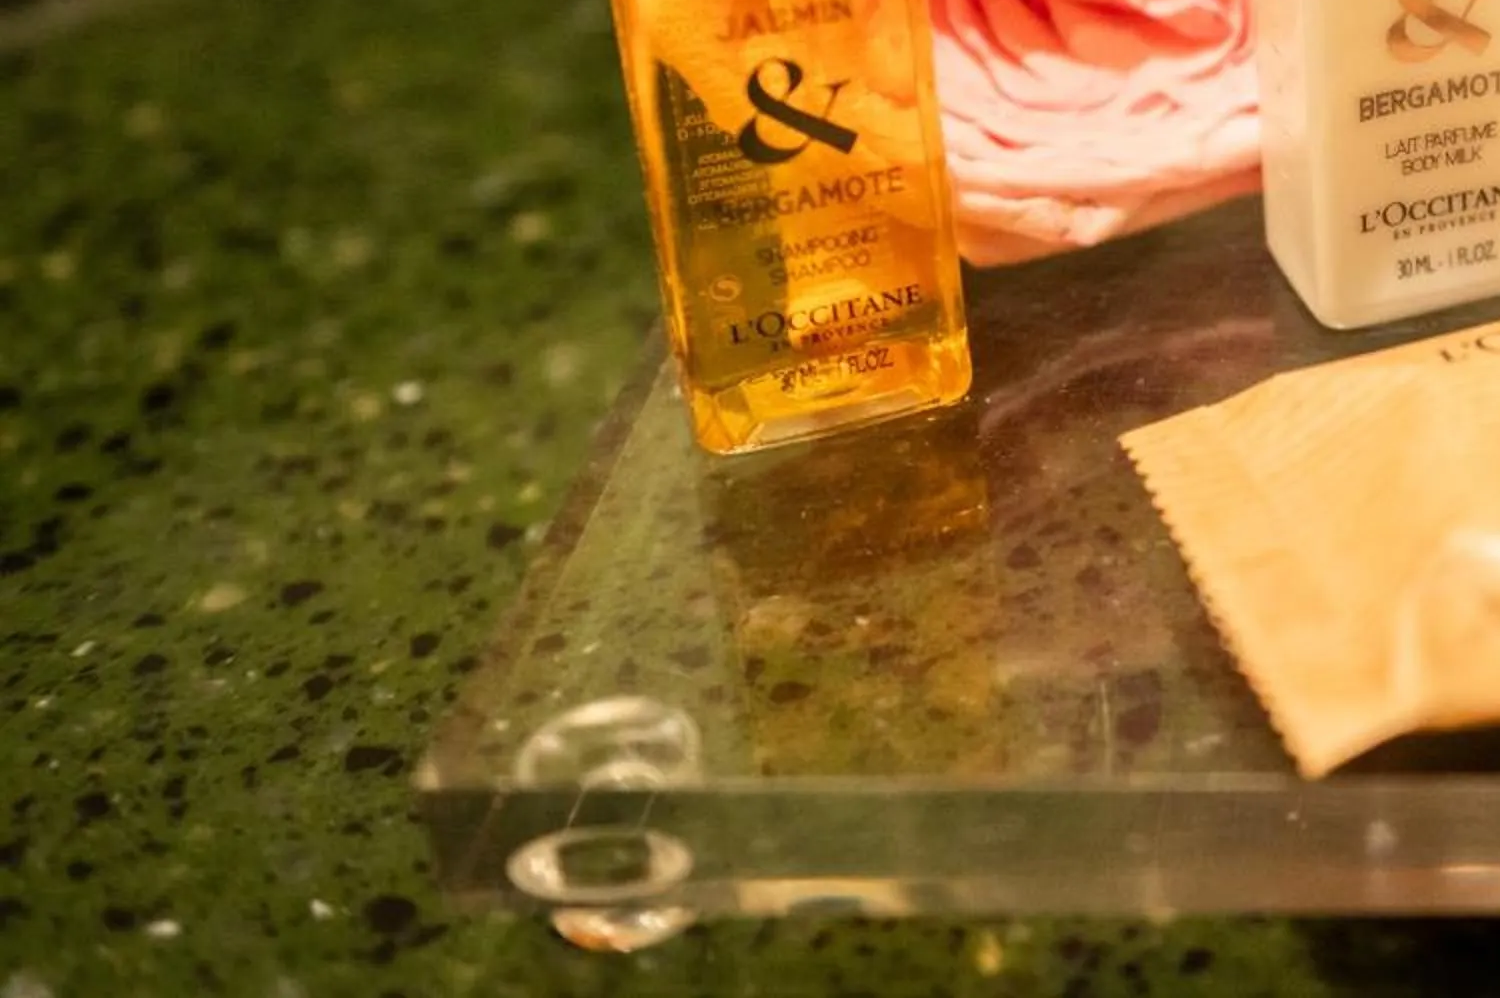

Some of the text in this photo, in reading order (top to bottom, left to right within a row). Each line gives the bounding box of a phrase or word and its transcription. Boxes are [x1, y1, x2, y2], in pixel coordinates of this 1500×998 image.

[738, 57, 858, 165] &
[1385, 135, 1421, 159] LAIT
[1401, 145, 1483, 176] BODY MILK
[713, 167, 905, 226] BERGAMOTE
[1419, 210, 1496, 234] PROVENCE
[1415, 254, 1435, 274] ML
[730, 284, 923, 344] L'OCCITANE
